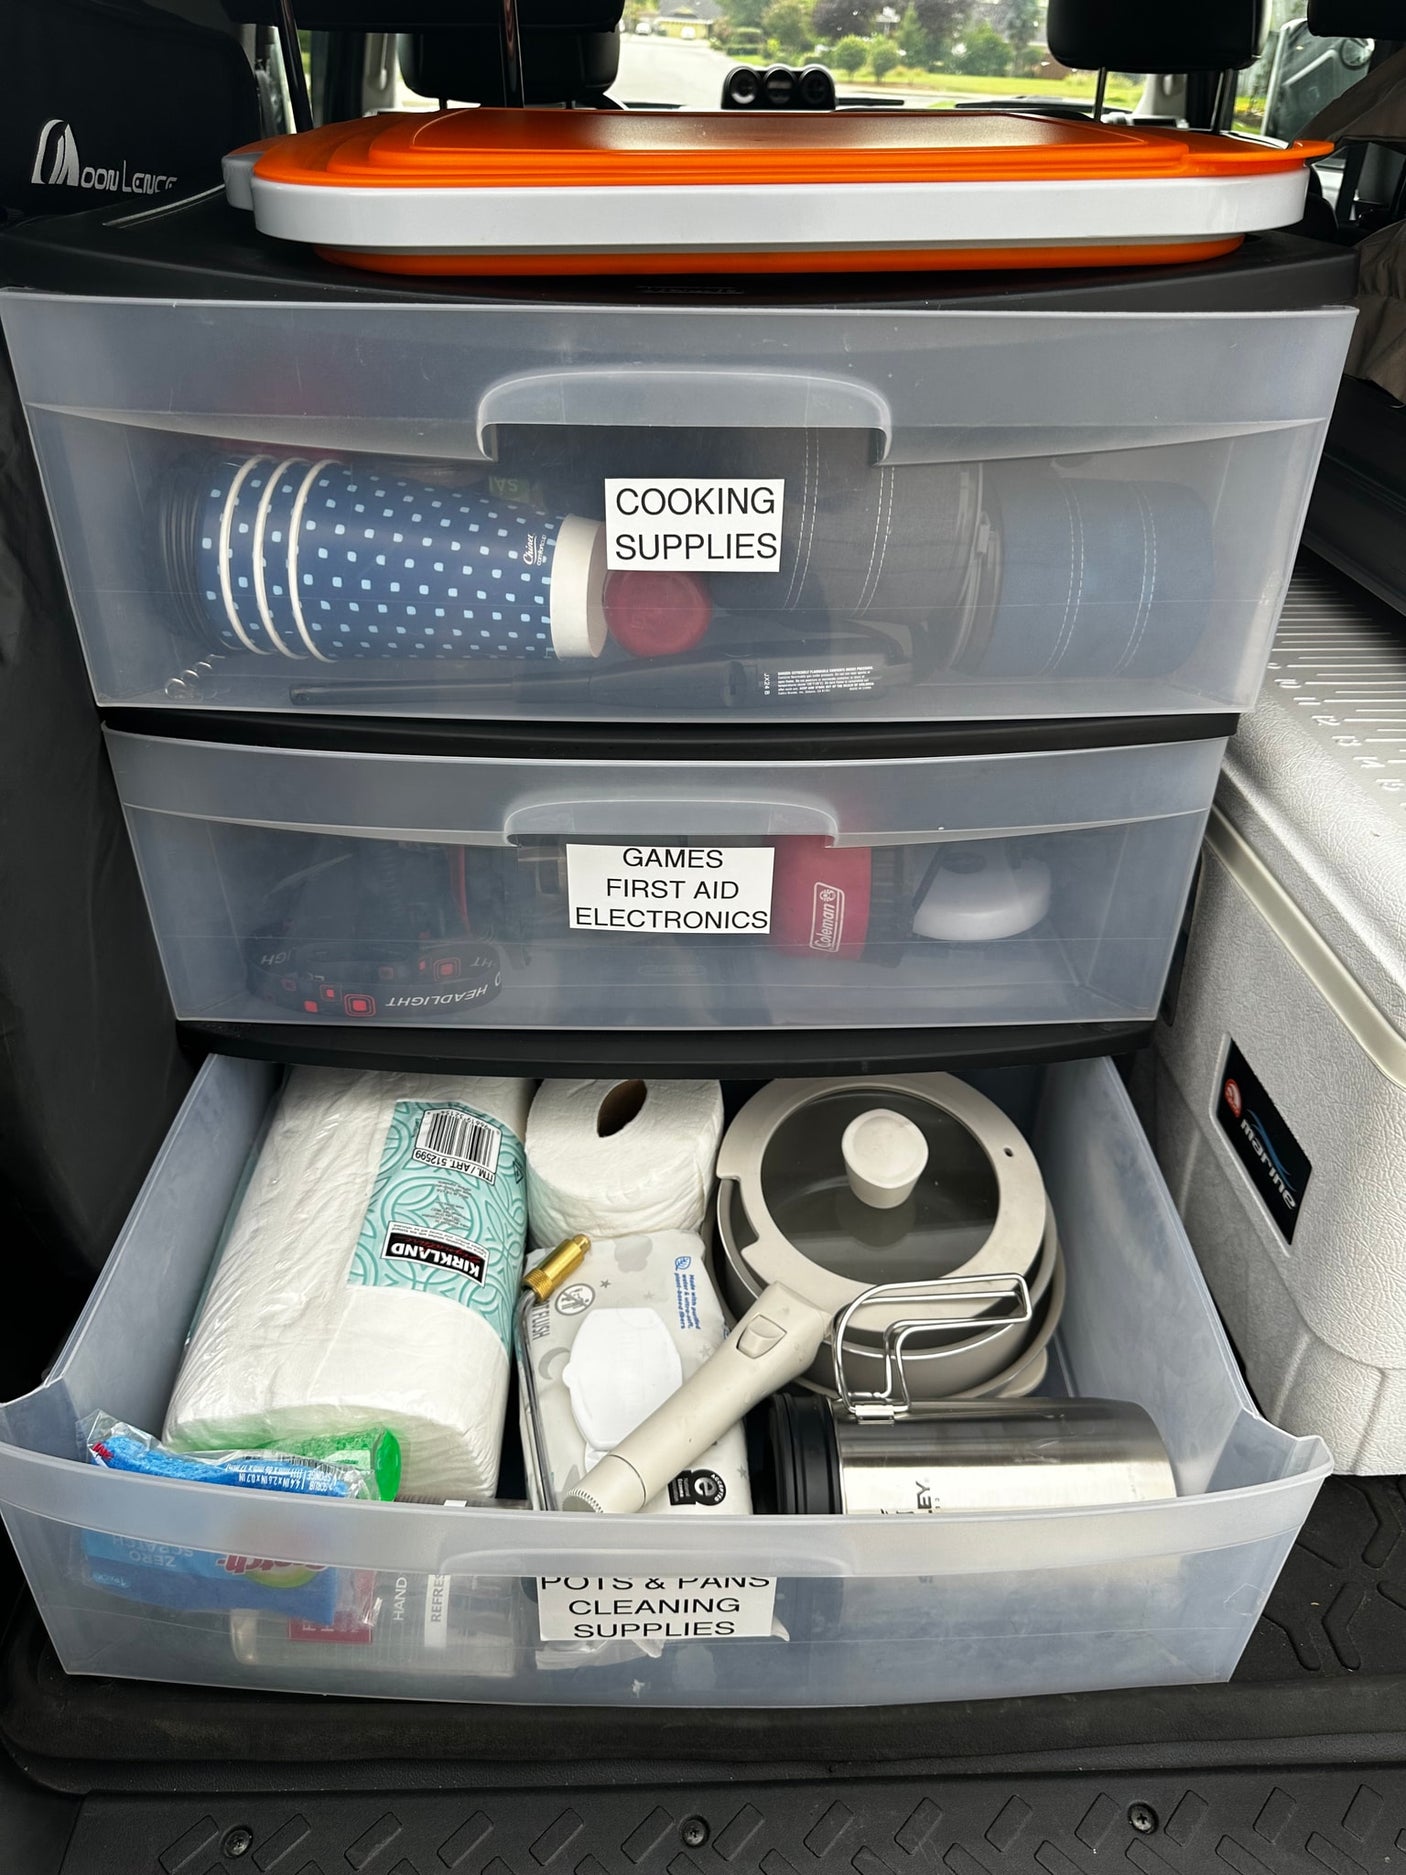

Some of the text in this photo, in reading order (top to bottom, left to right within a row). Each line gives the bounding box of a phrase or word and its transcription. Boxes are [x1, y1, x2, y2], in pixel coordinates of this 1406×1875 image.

[616, 487, 775, 516] COOKING
[615, 533, 777, 560] SUPPLIES
[622, 847, 723, 869] GAMES
[606, 878, 739, 899] FIRST AID
[575, 906, 768, 930] ELECTRONICS
[814, 903, 836, 948] Coleman
[385, 984, 488, 1007] HEADLIGHT
[415, 1150, 448, 1167] 512599
[450, 1159, 471, 1171] ART.
[1240, 1119, 1297, 1210] marine
[478, 1167, 494, 1183] ITM.
[391, 1242, 480, 1278] KIRKLAND
[532, 1310, 550, 1341] FLUSH
[711, 1473, 725, 1502] ACCEPTED
[129, 1551, 176, 1568] ZERO
[541, 1577, 770, 1590] POTS & PANS
[392, 1576, 408, 1621] HAND
[568, 1598, 740, 1615] CLEANING
[574, 1621, 735, 1638] SUPPLIES
